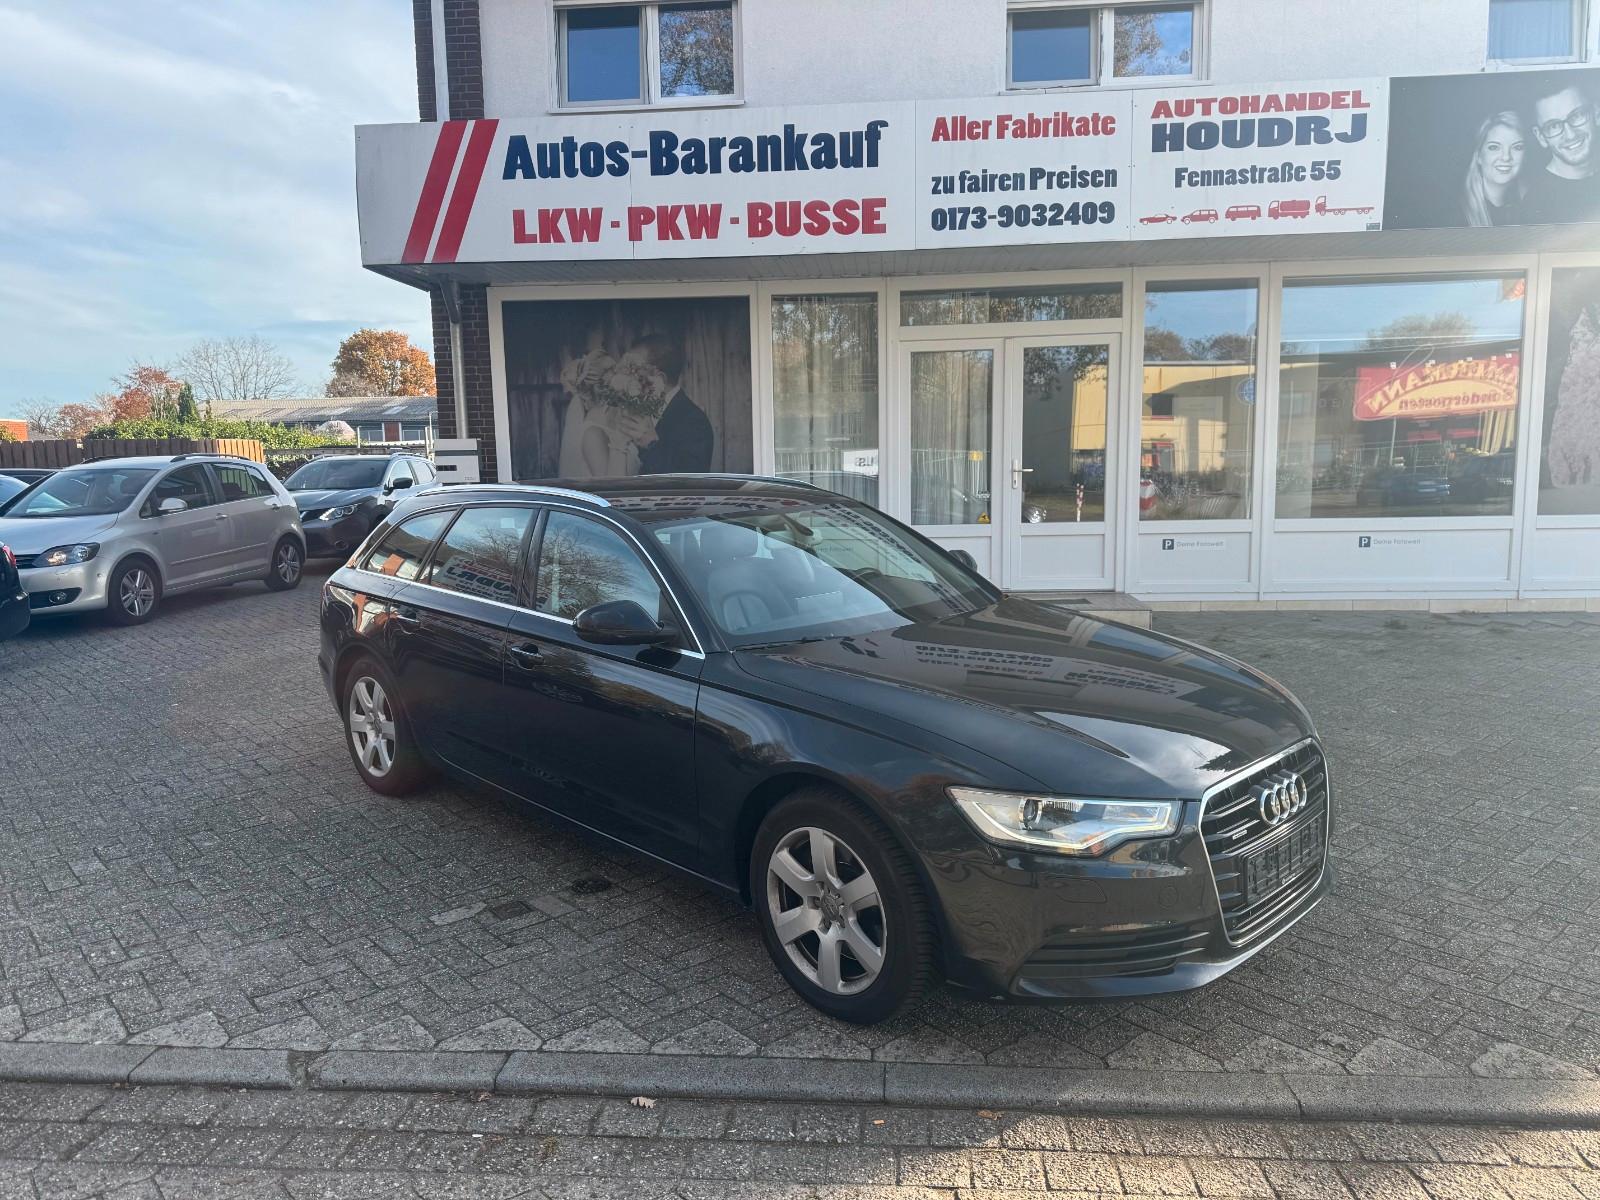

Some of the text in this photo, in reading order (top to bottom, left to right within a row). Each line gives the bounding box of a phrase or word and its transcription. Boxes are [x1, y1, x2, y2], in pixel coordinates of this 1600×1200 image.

[1151, 90, 1370, 119] AUTOHANDEL
[931, 112, 1116, 142] Aller Fabrikate
[1151, 113, 1368, 153] HOUDRJ
[502, 120, 889, 181] Autos-Barankauf
[931, 166, 1118, 195] zu fairen Preisen
[1174, 160, 1342, 188] Fennastraße 55
[513, 208, 601, 243] LKW
[628, 204, 722, 242] PKW
[747, 198, 887, 238] BUSSE
[931, 201, 1116, 231] 0173-9032409
